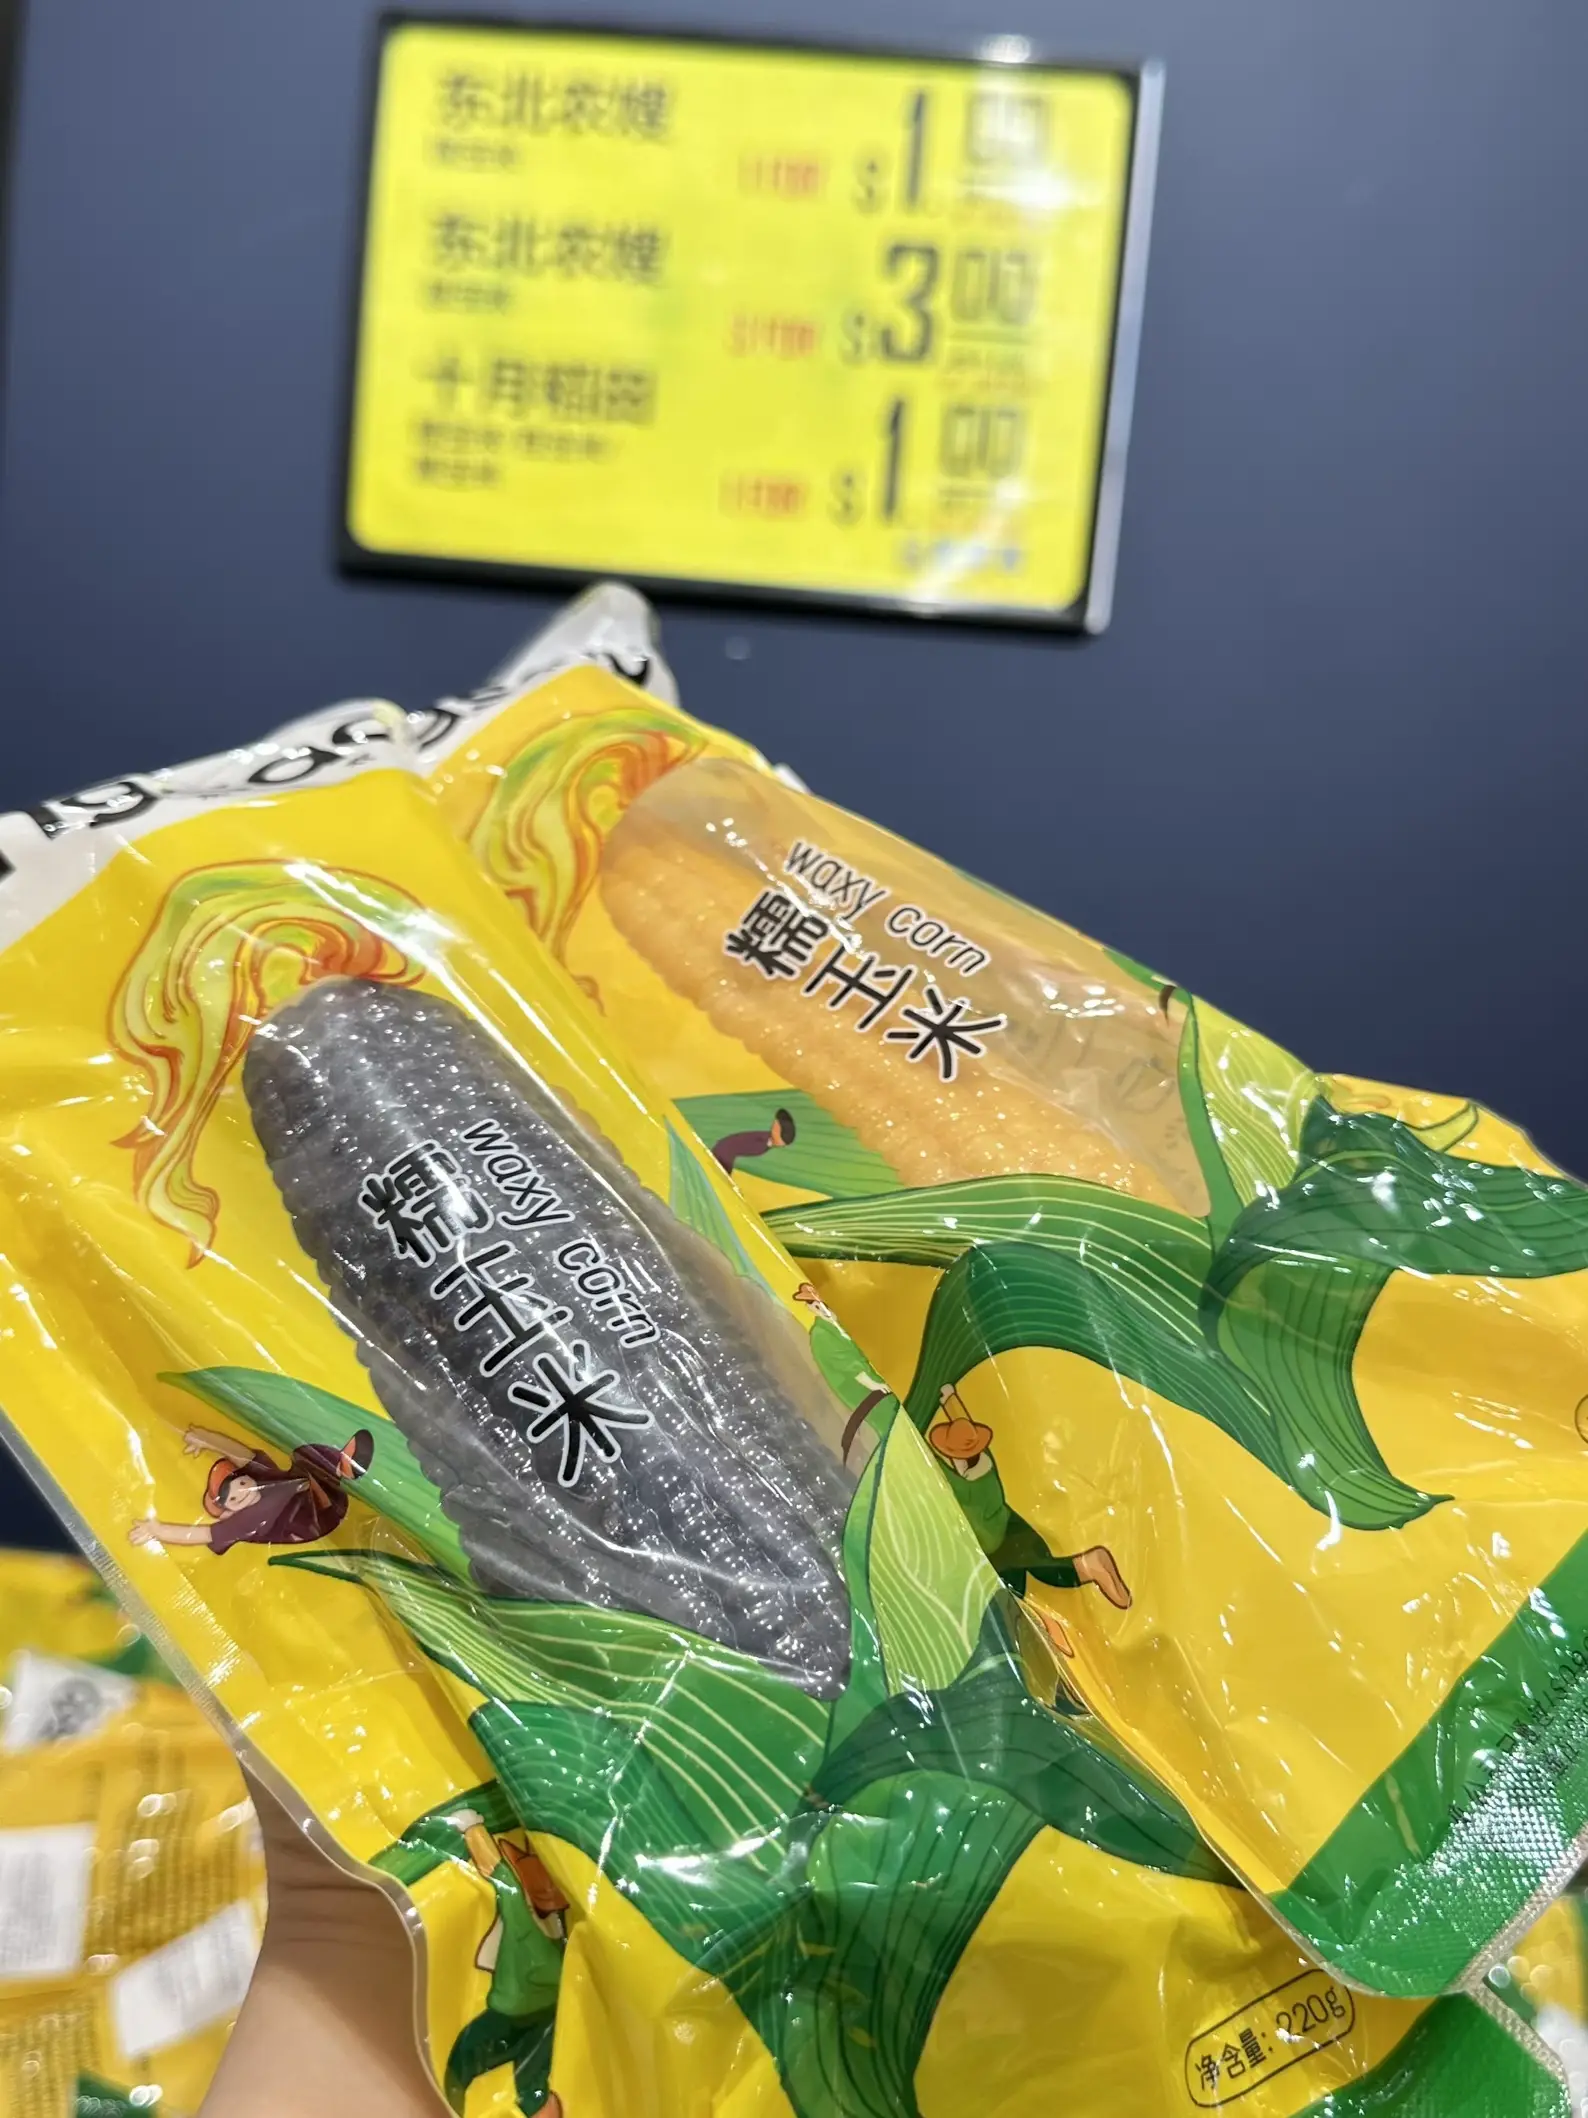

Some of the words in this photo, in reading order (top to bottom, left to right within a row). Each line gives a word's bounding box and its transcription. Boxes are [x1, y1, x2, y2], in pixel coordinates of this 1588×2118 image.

[726, 891, 1003, 1080] 糯玉米
[785, 842, 886, 921] waxy
[888, 905, 989, 975] corn
[362, 1142, 651, 1484] 糯玉米
[463, 1120, 571, 1227] waxy
[559, 1241, 658, 1346] corn
